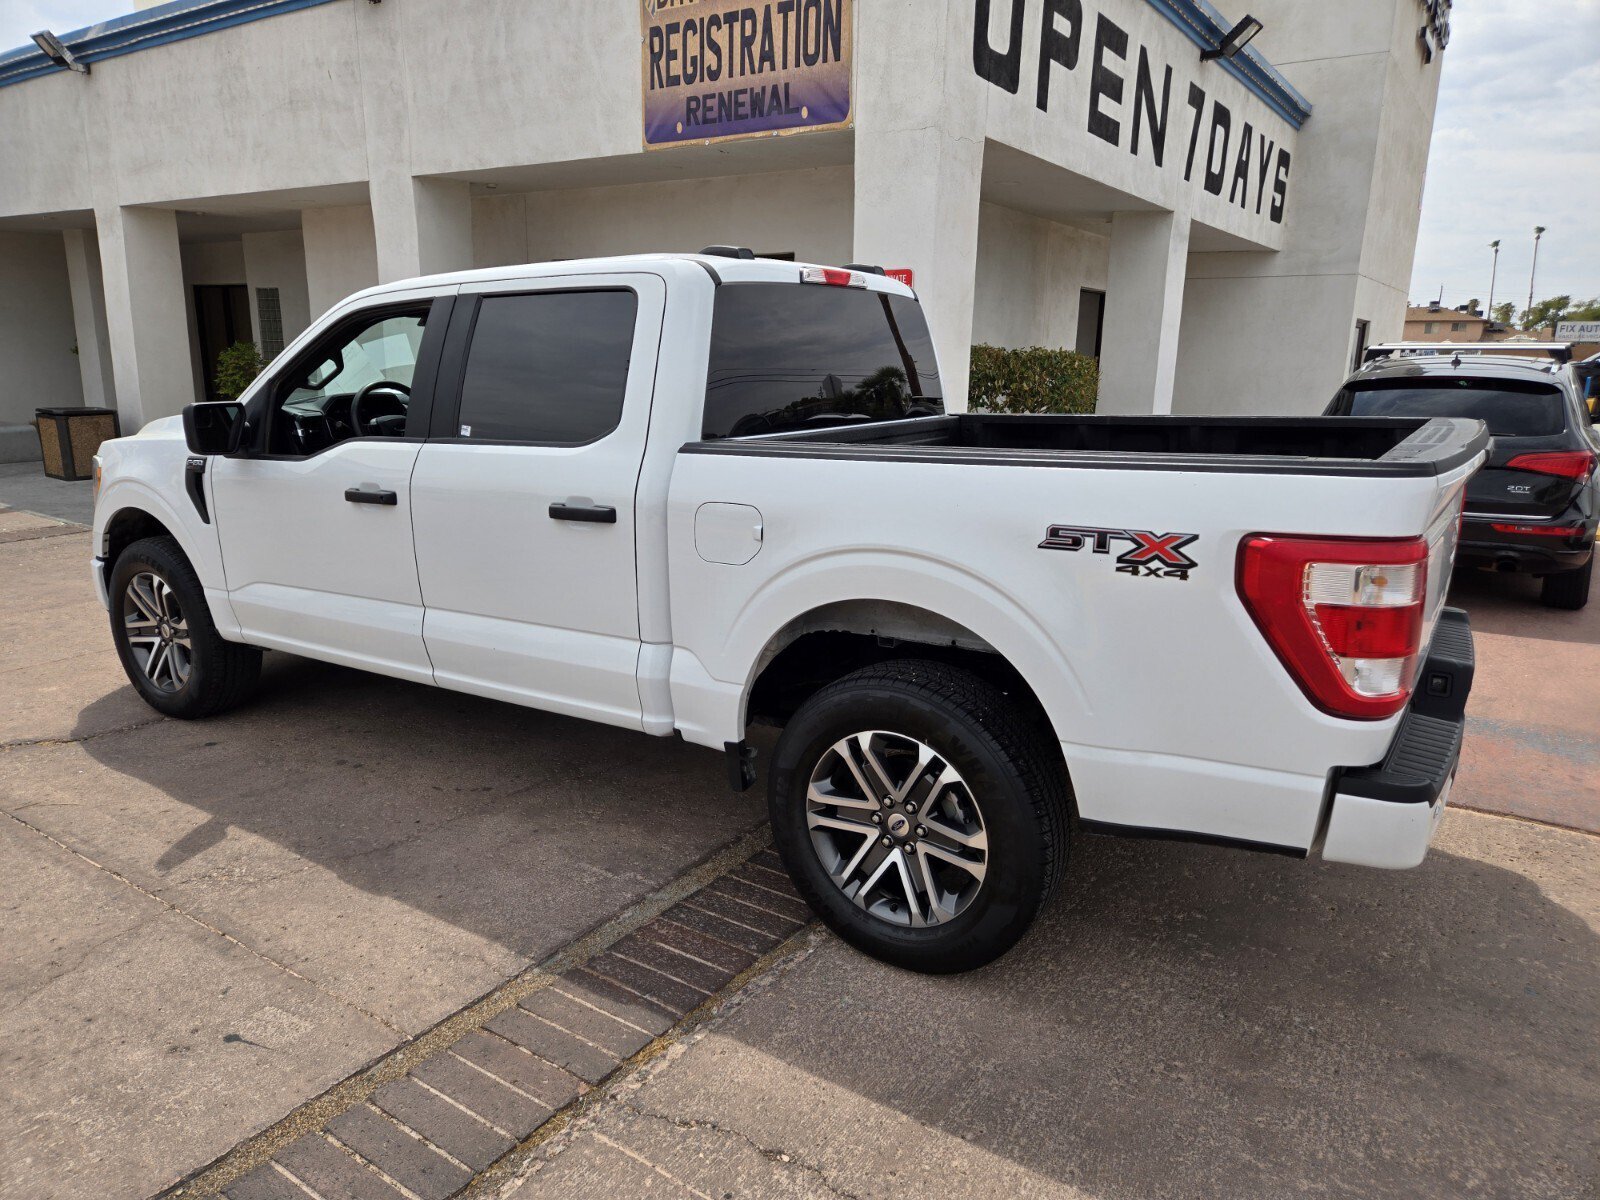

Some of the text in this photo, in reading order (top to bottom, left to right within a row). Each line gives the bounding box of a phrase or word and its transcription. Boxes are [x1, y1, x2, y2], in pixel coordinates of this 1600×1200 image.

[650, 0, 842, 91] REGISTRATION
[686, 82, 800, 127] RENEWAL
[973, 0, 1291, 224] OPEN 7 DAYS
[1560, 324, 1576, 333] FIX
[1037, 524, 1199, 570] STX
